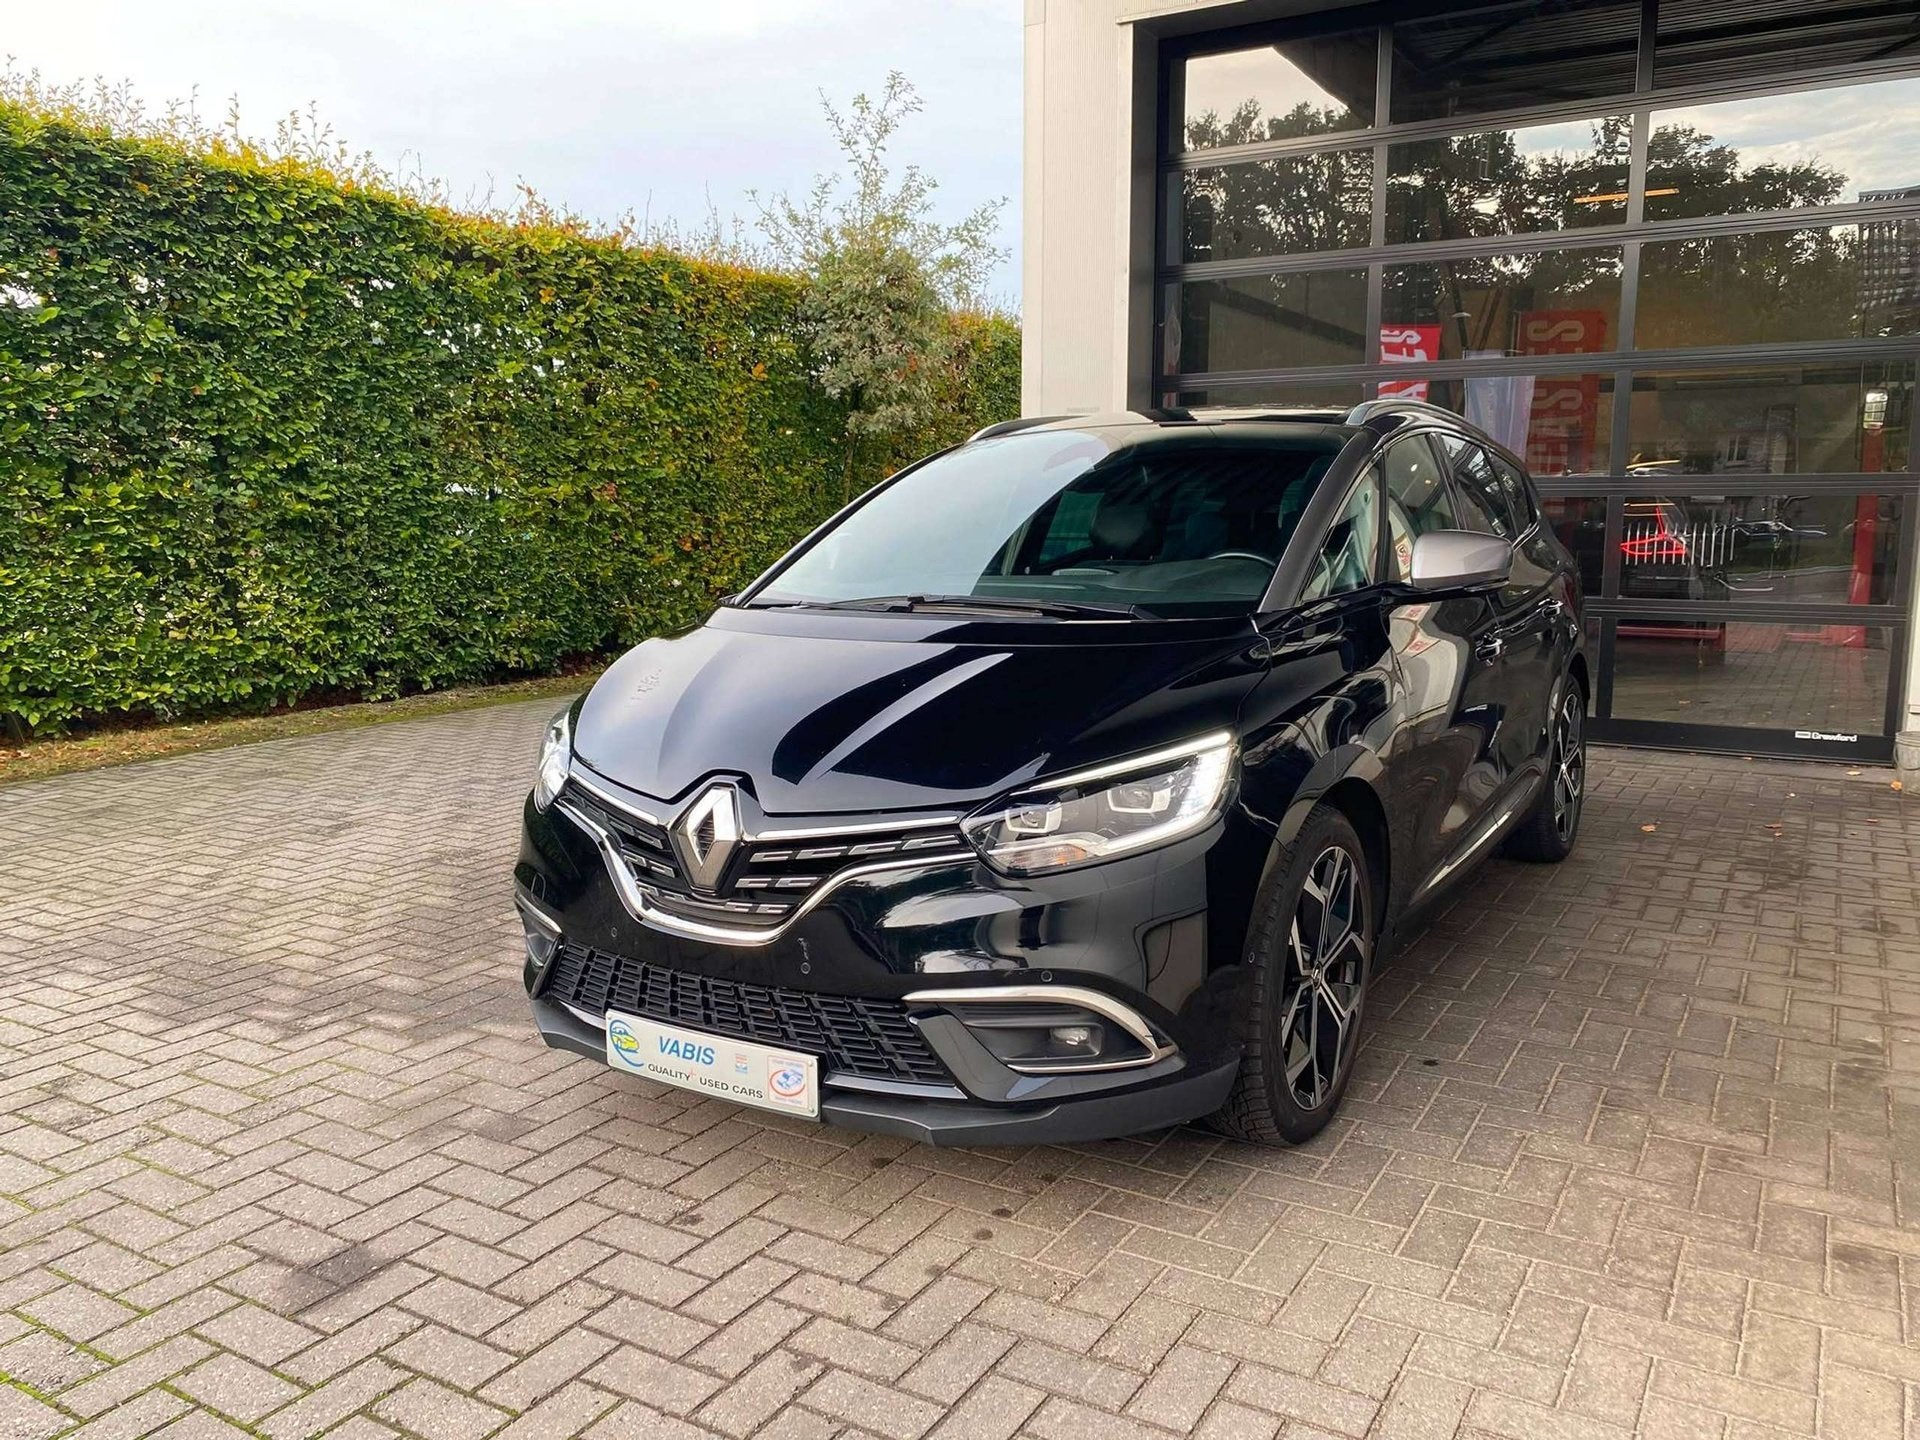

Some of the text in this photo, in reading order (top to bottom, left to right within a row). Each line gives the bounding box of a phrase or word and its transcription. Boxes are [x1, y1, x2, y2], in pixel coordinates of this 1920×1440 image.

[659, 1035, 715, 1065] VABIS
[700, 1077, 729, 1091] USED
[732, 1085, 763, 1099] CARS
